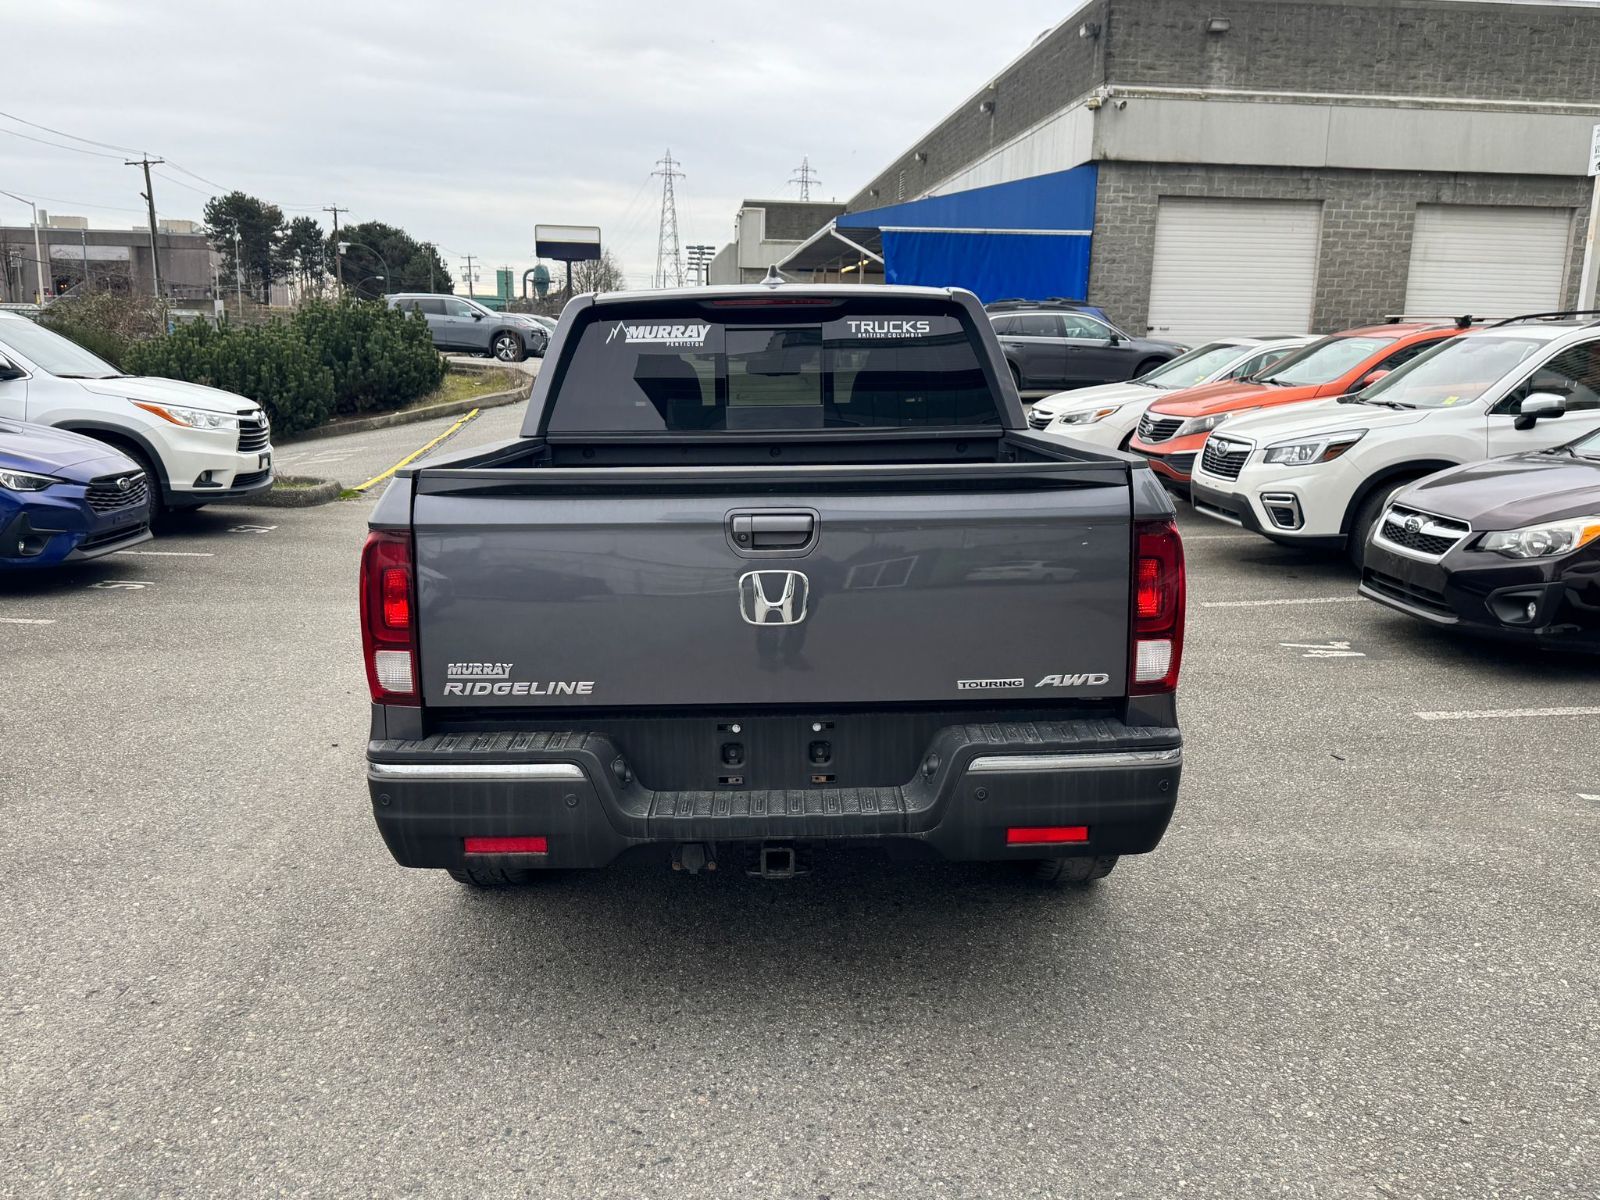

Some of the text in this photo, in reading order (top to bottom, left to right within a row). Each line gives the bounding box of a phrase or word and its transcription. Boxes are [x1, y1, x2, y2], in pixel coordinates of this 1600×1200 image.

[627, 325, 712, 341] MURRAY
[847, 320, 930, 333] TRUCKS
[447, 663, 514, 677] MURRAY
[958, 680, 1024, 689] TOURING
[1034, 673, 1110, 688] AWD
[443, 681, 595, 696] RIDGELINE
